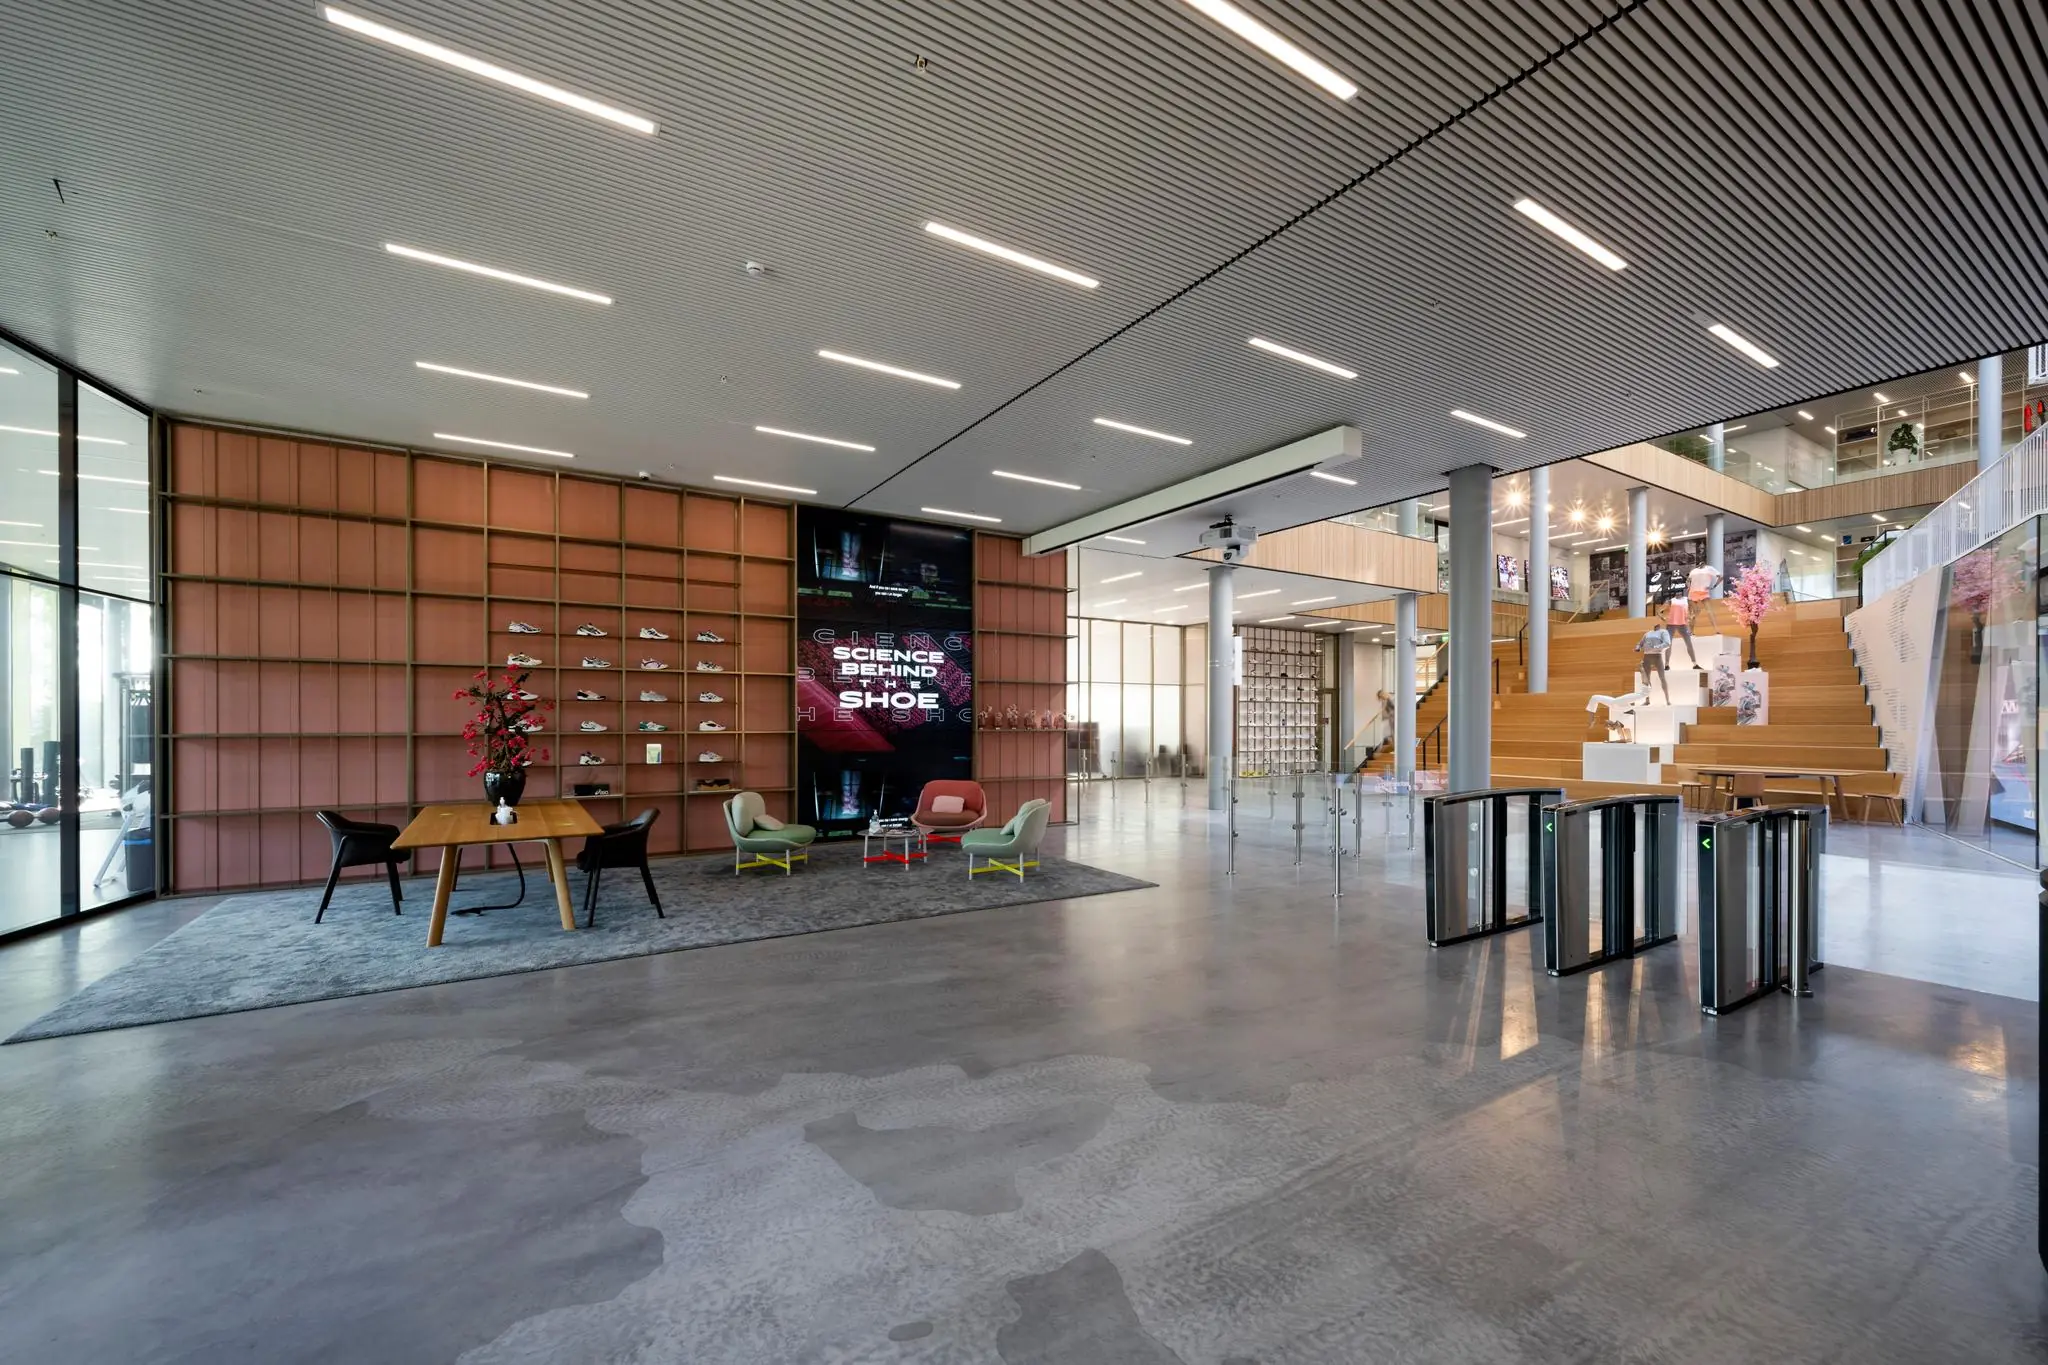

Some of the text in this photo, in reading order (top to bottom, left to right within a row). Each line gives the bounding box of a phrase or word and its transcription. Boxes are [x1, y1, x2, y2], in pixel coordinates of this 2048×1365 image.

[833, 646, 945, 664] SCIENCE
[841, 662, 938, 678] BEHIND
[859, 679, 921, 689] THE
[839, 690, 940, 709] SHOE
